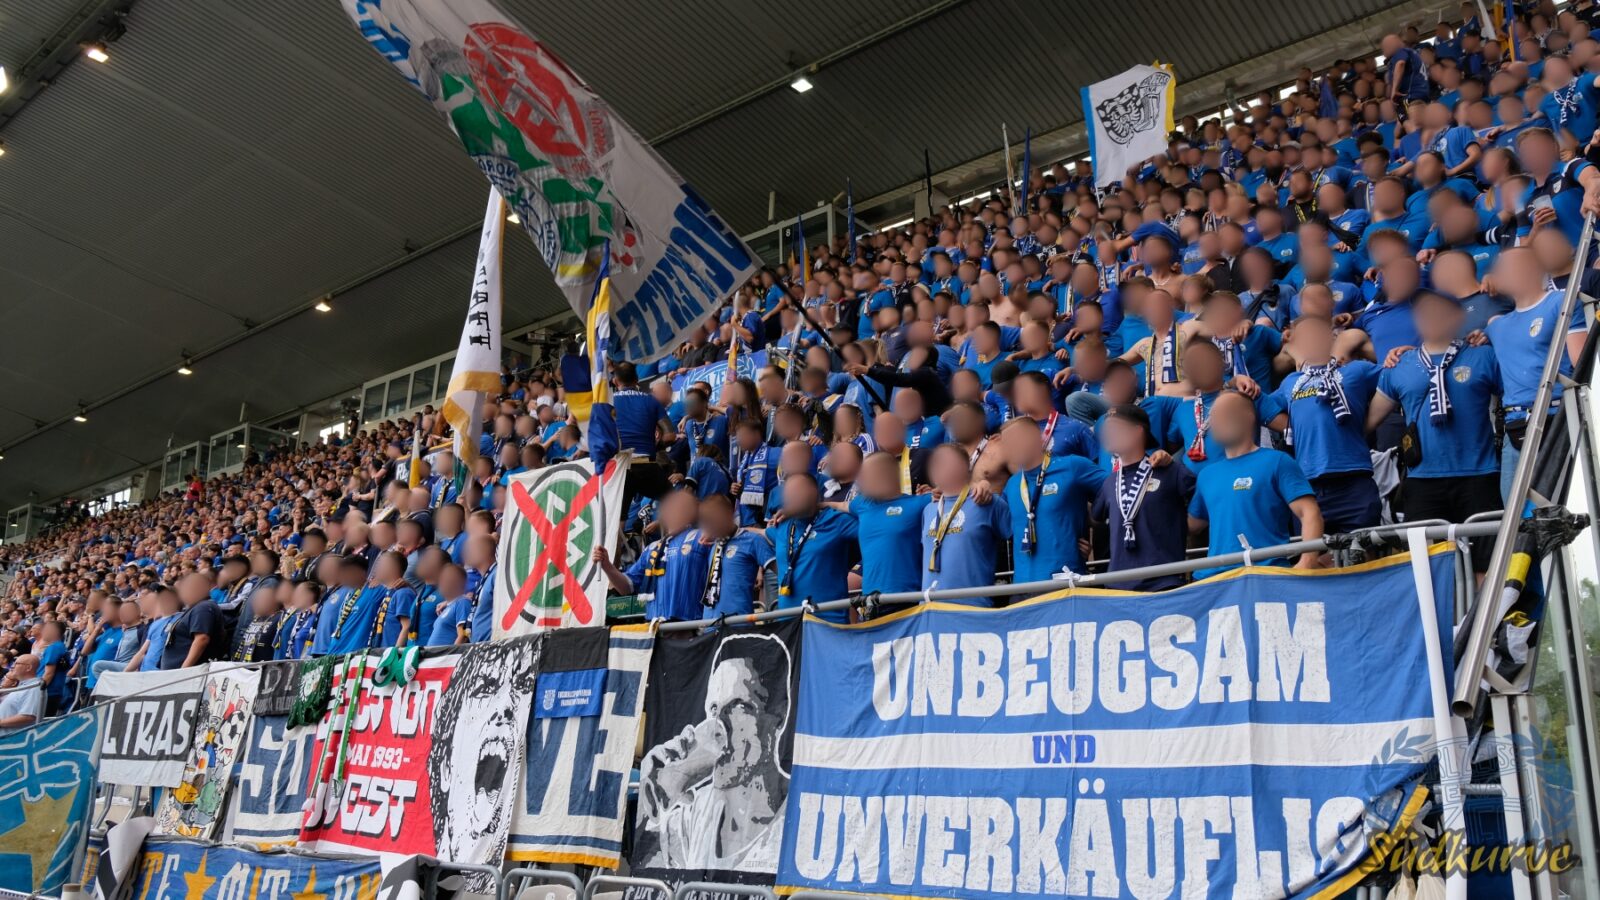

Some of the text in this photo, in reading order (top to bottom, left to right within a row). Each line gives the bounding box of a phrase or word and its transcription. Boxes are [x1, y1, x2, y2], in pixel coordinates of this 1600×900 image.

[871, 600, 1332, 721] UNBEUGSAM
[97, 698, 198, 756] LTRAS
[1032, 734, 1096, 765] UND
